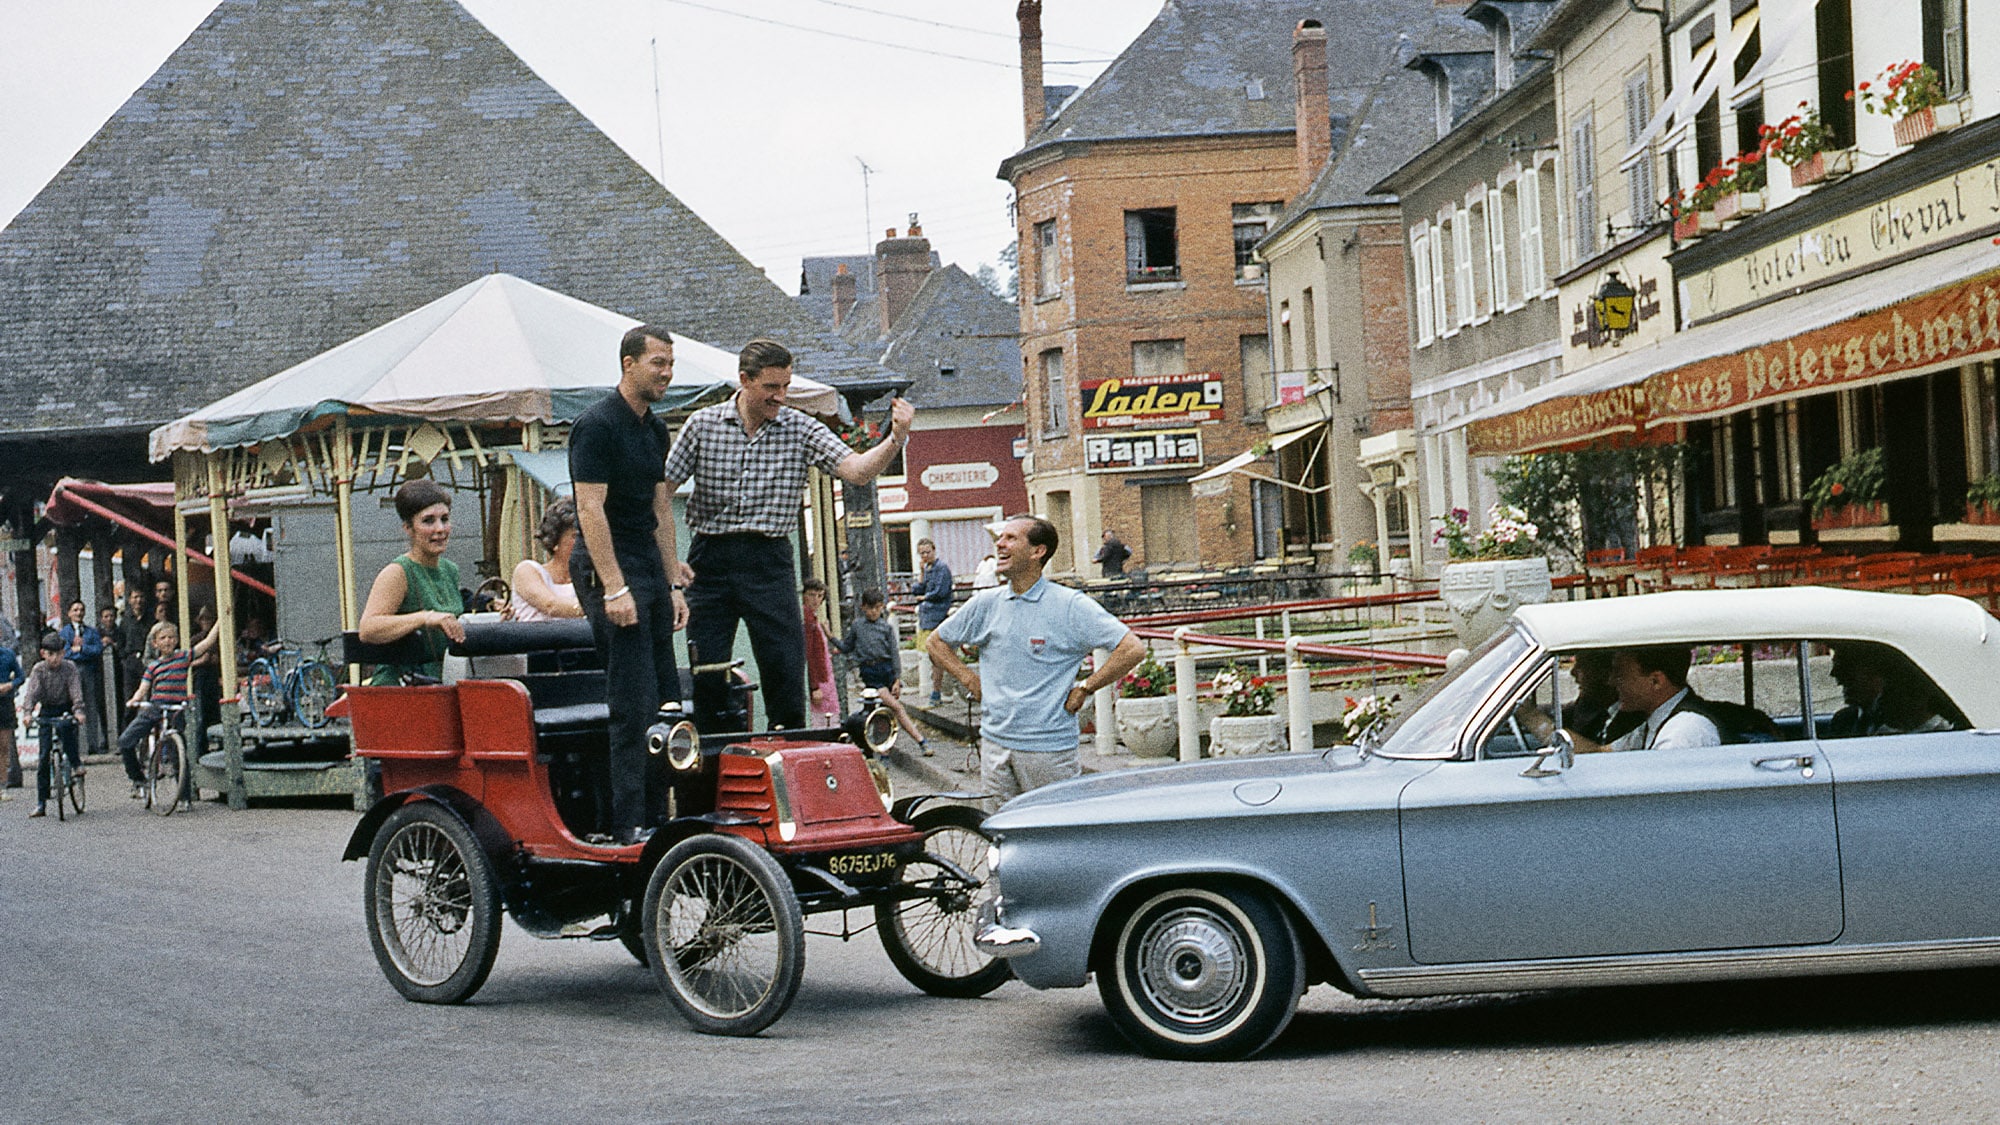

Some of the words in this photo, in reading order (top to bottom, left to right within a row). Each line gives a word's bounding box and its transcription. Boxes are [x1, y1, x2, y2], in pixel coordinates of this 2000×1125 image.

[1744, 234, 1805, 292] Hotel
[1870, 173, 1966, 250] Cheval
[1084, 379, 1220, 417] Laden
[1088, 434, 1198, 466] Rapha
[928, 470, 989, 484] CHARCUTERIE
